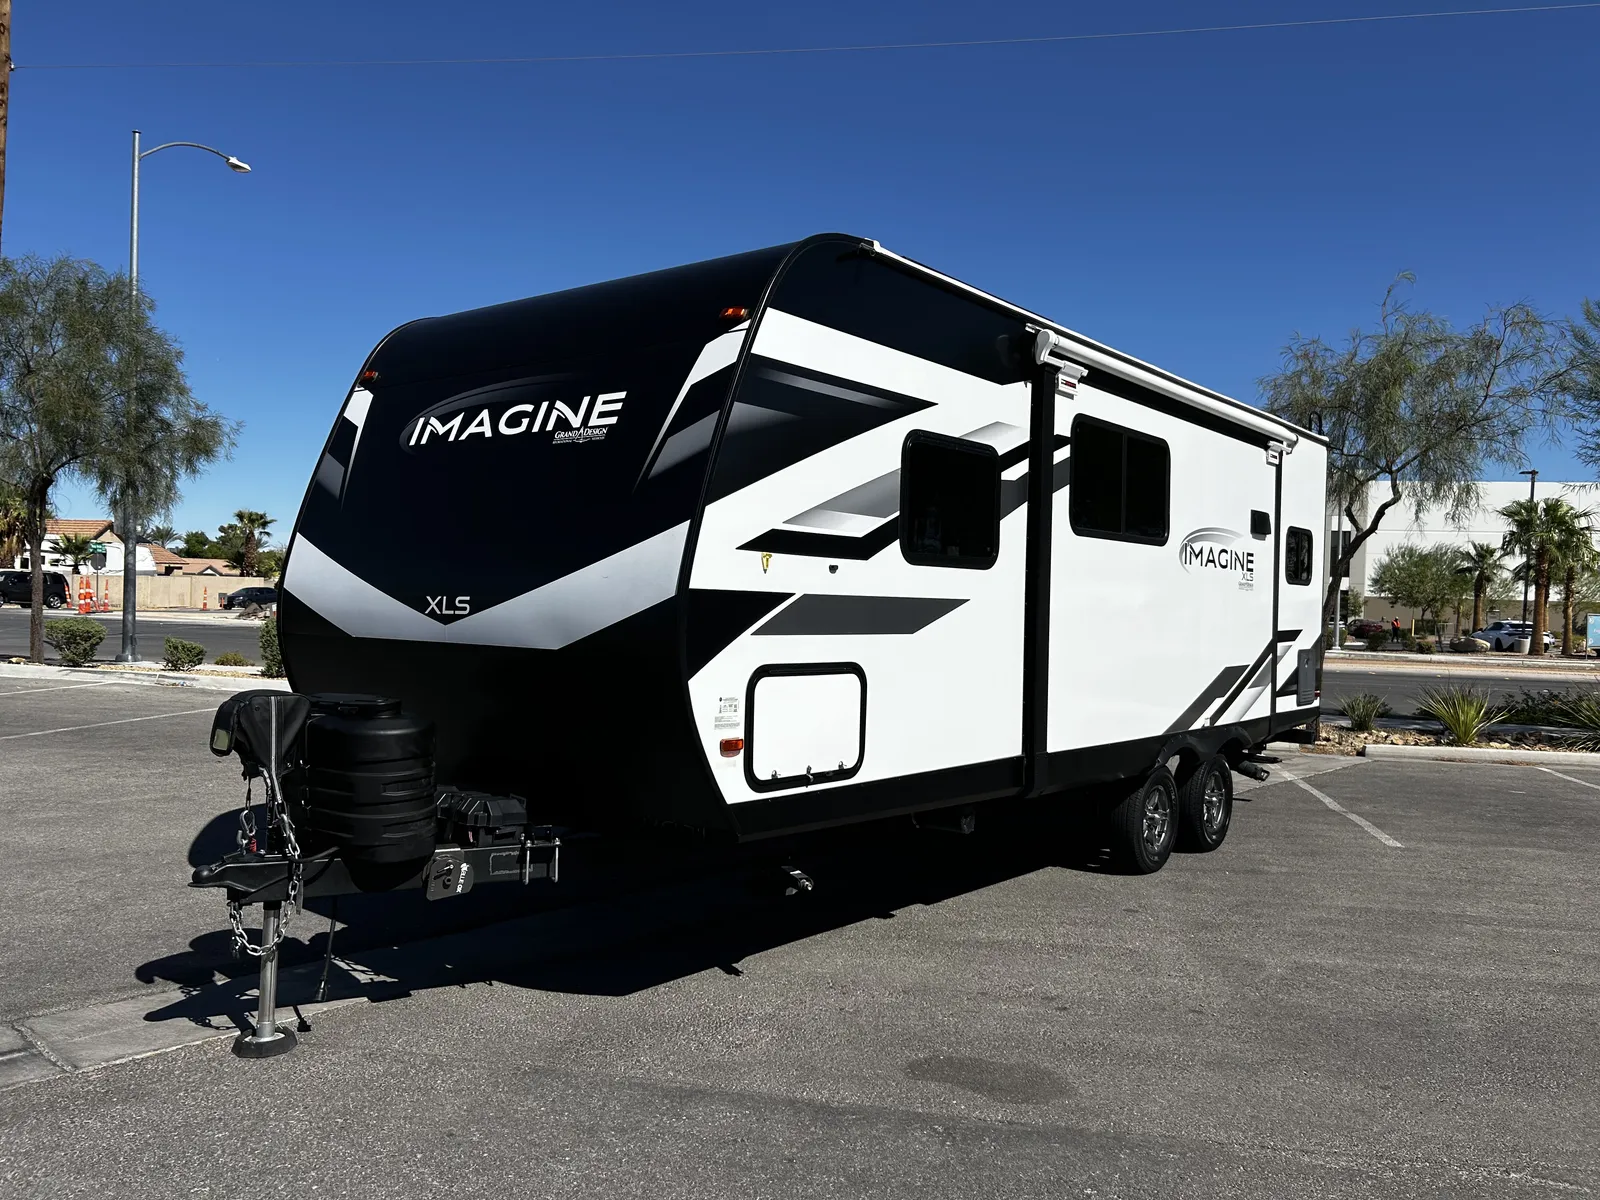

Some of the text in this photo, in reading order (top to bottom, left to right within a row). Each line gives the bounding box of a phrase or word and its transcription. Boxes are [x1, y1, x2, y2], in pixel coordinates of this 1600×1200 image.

[409, 391, 627, 446] IMAGINE
[1184, 542, 1254, 572] IMAGINE
[1241, 572, 1254, 581] XLS
[425, 596, 470, 614] XLS
